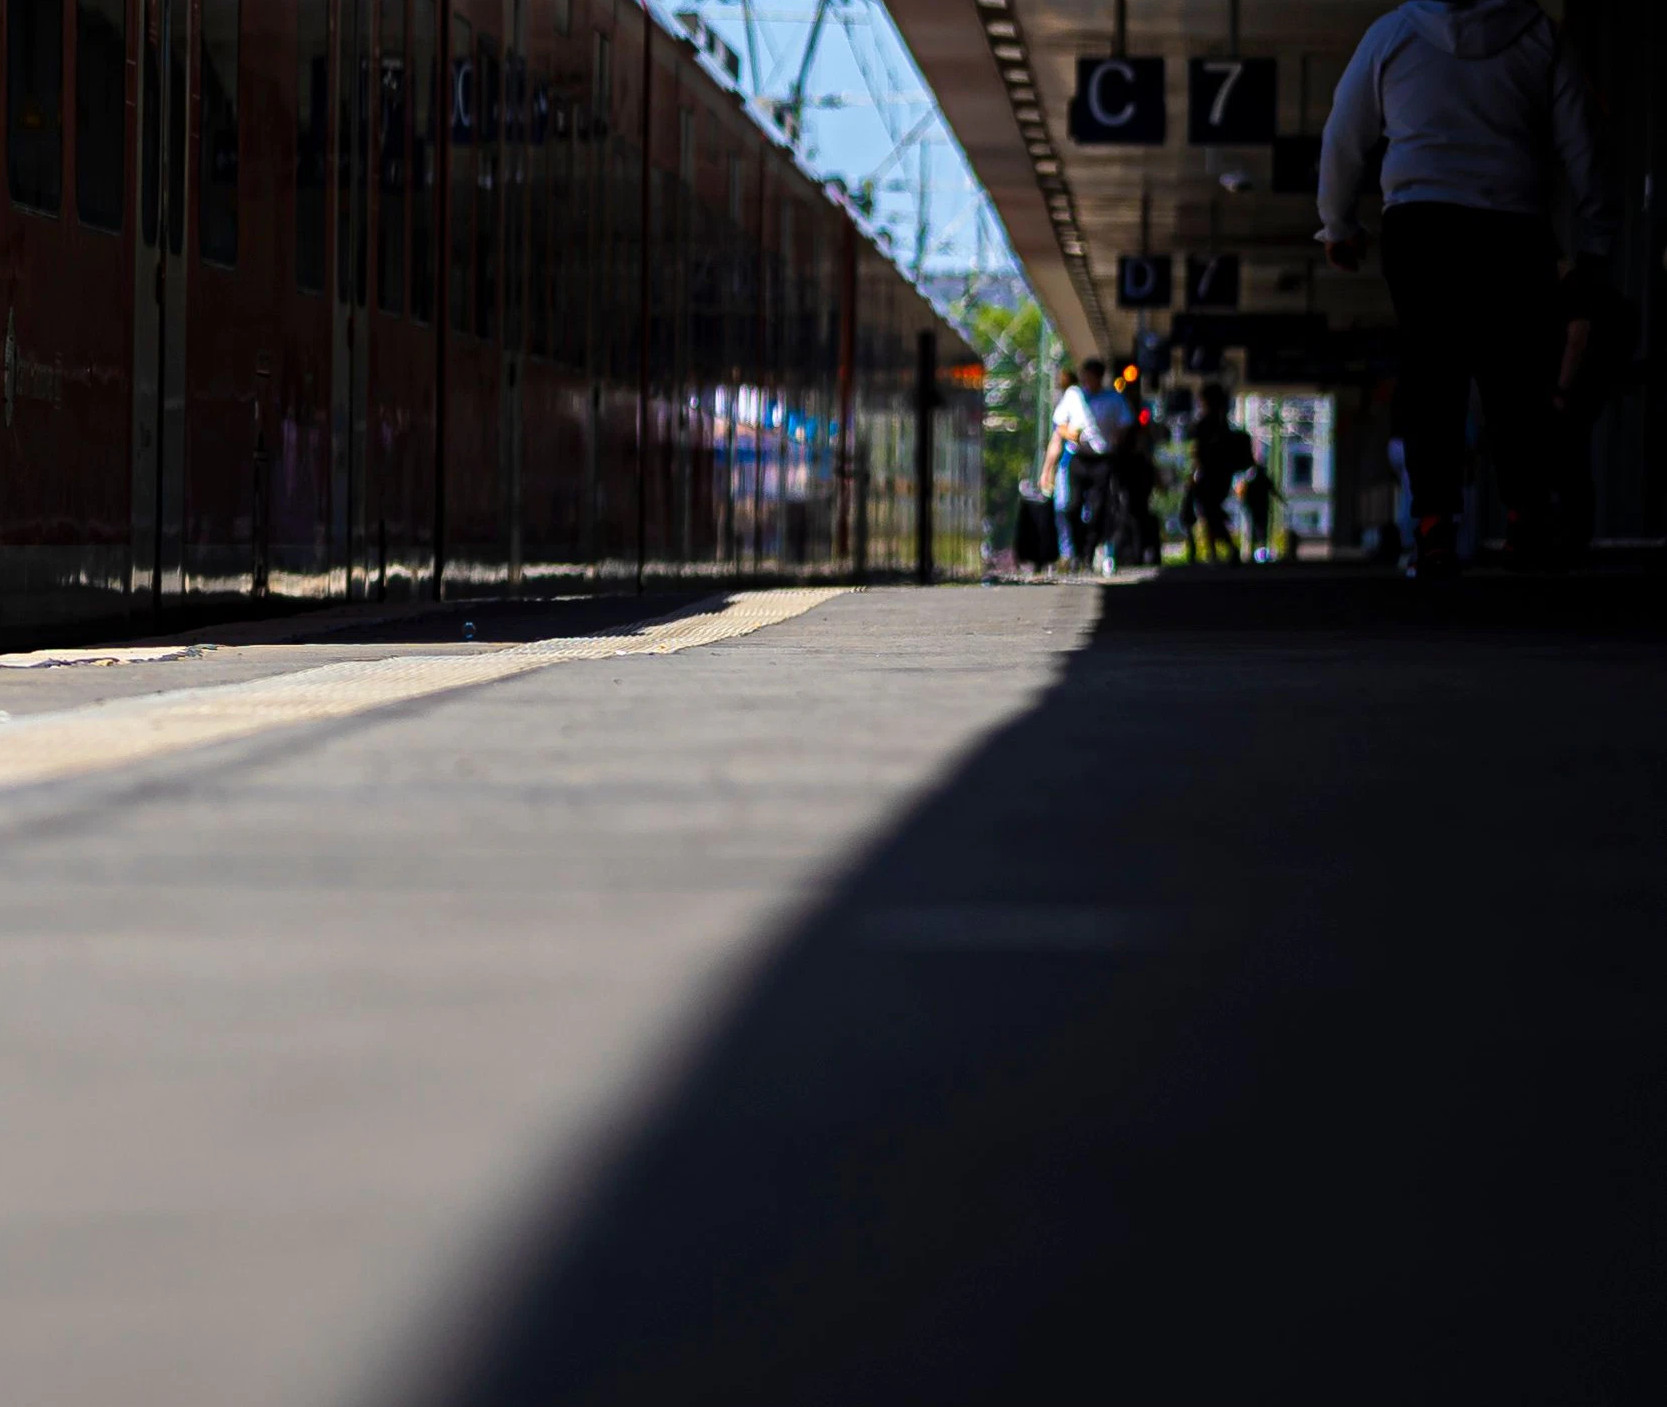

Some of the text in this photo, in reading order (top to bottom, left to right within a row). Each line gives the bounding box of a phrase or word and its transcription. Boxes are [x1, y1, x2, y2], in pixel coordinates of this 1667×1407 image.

[1088, 59, 1135, 126] C
[1203, 61, 1243, 126] 7
[1125, 259, 1156, 299] D
